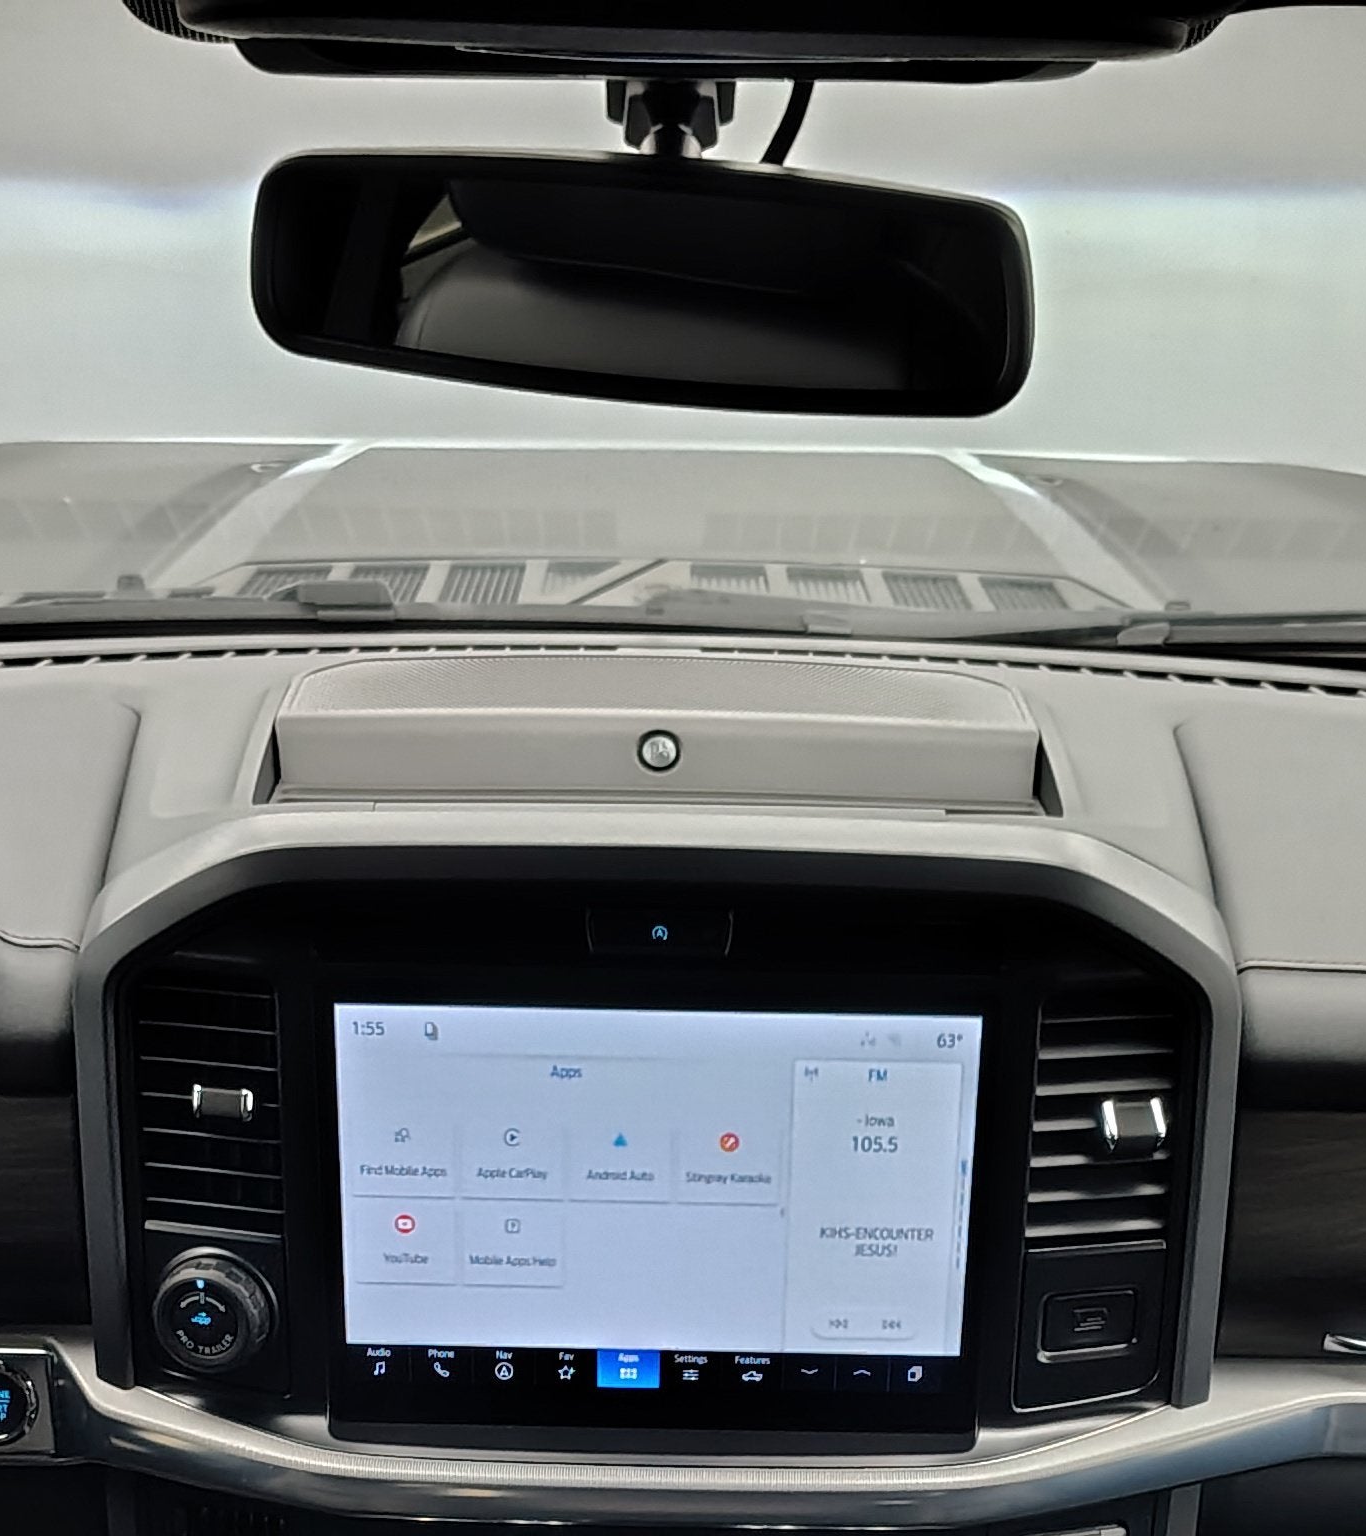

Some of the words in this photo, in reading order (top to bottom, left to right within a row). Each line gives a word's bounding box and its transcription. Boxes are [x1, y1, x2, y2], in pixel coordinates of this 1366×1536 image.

[352, 1021, 385, 1036] 1:55
[550, 1065, 583, 1079] Apps
[868, 1069, 887, 1082] FM
[865, 1114, 895, 1127] Iowa
[852, 1136, 898, 1153] 105.5
[421, 1166, 447, 1178] Apps
[384, 1253, 429, 1264] YouTube
[176, 1329, 195, 1349] PRO
[197, 1334, 234, 1354] TRAILER
[366, 1348, 391, 1357] Audio
[428, 1349, 455, 1358] Phone
[496, 1351, 513, 1360] Nav
[559, 1352, 574, 1361] Fav
[674, 1354, 708, 1365] Settings
[734, 1356, 771, 1365] Features
